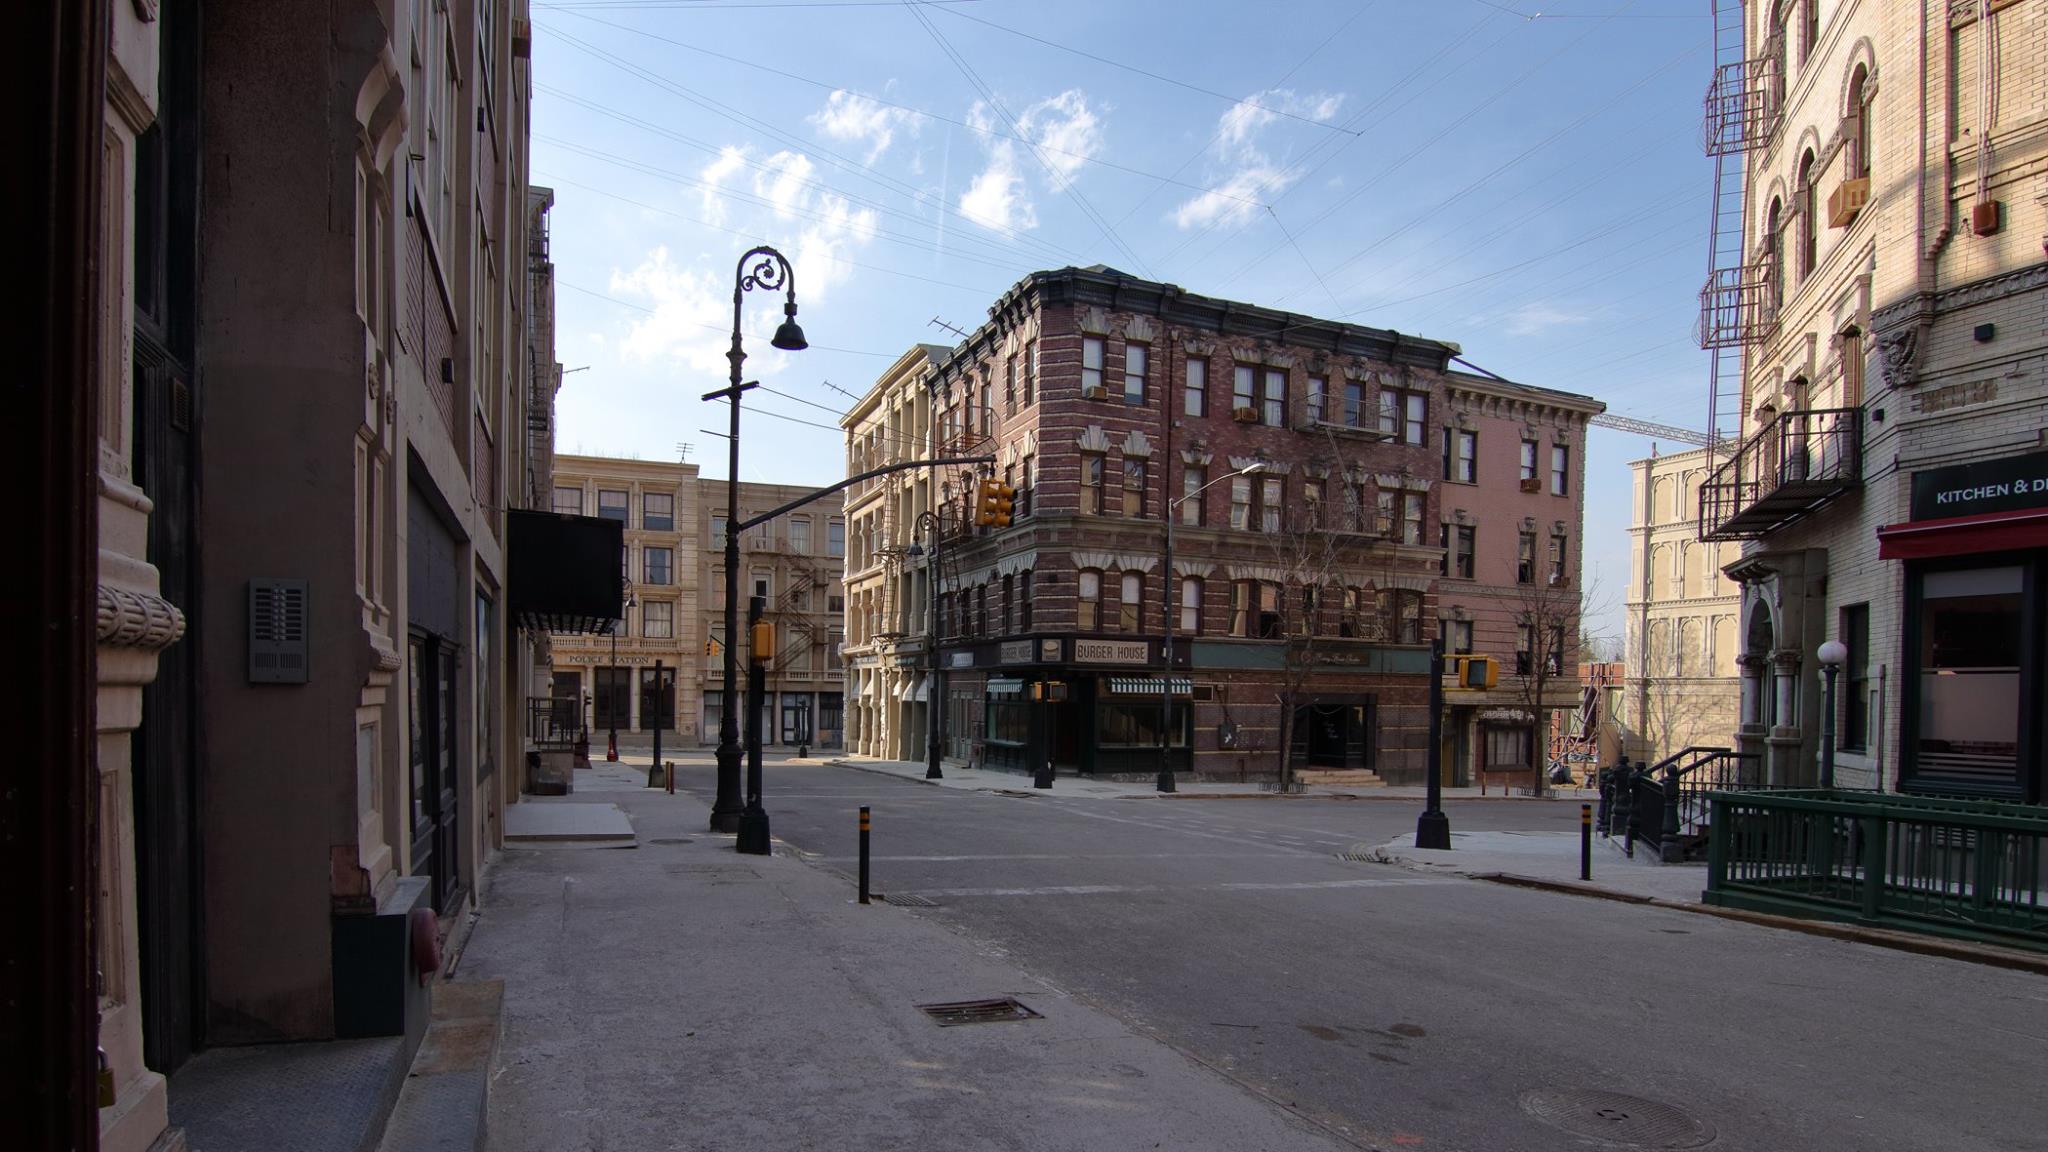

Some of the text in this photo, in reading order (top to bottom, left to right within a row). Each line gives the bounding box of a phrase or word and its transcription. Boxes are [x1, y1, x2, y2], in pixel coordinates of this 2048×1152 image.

[1937, 483, 2009, 504] KITCHEN
[2014, 479, 2028, 494] &
[569, 655, 603, 664] POLICE
[1077, 644, 1145, 660] BURGER HOUSE
